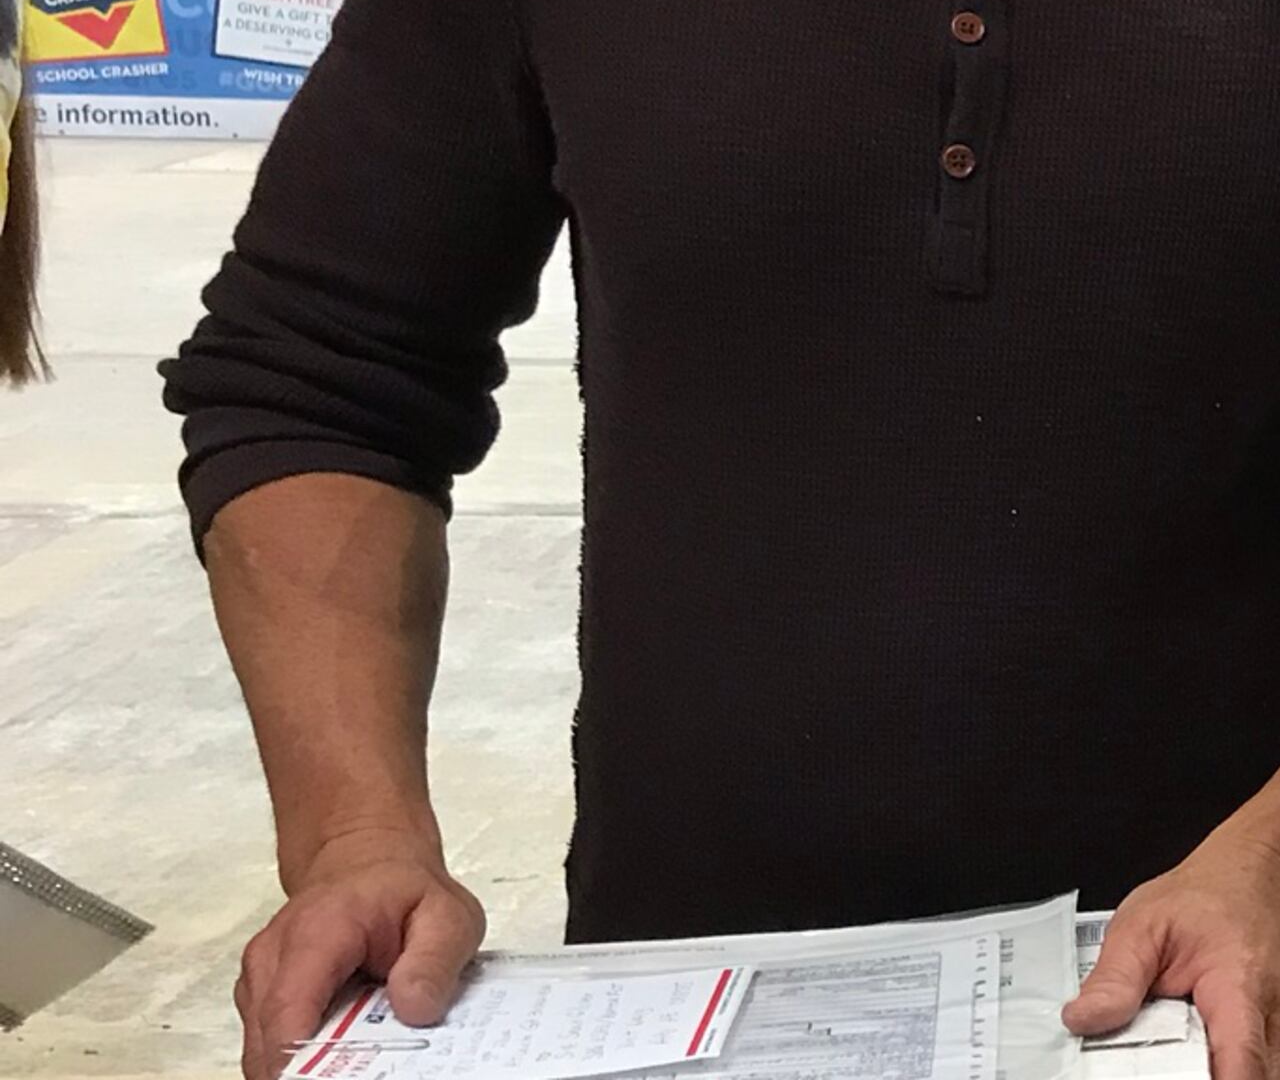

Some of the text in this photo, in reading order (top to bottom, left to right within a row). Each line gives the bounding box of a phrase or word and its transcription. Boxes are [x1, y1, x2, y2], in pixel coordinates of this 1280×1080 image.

[237, 2, 270, 18] GIVE
[275, 8, 285, 20] A
[289, 11, 320, 25] GIFT
[223, 18, 232, 30] A
[235, 18, 311, 41] DESERVING
[36, 62, 169, 84] SCHOOL CRASHER
[244, 68, 282, 85] WISH
[57, 103, 219, 128] information.
